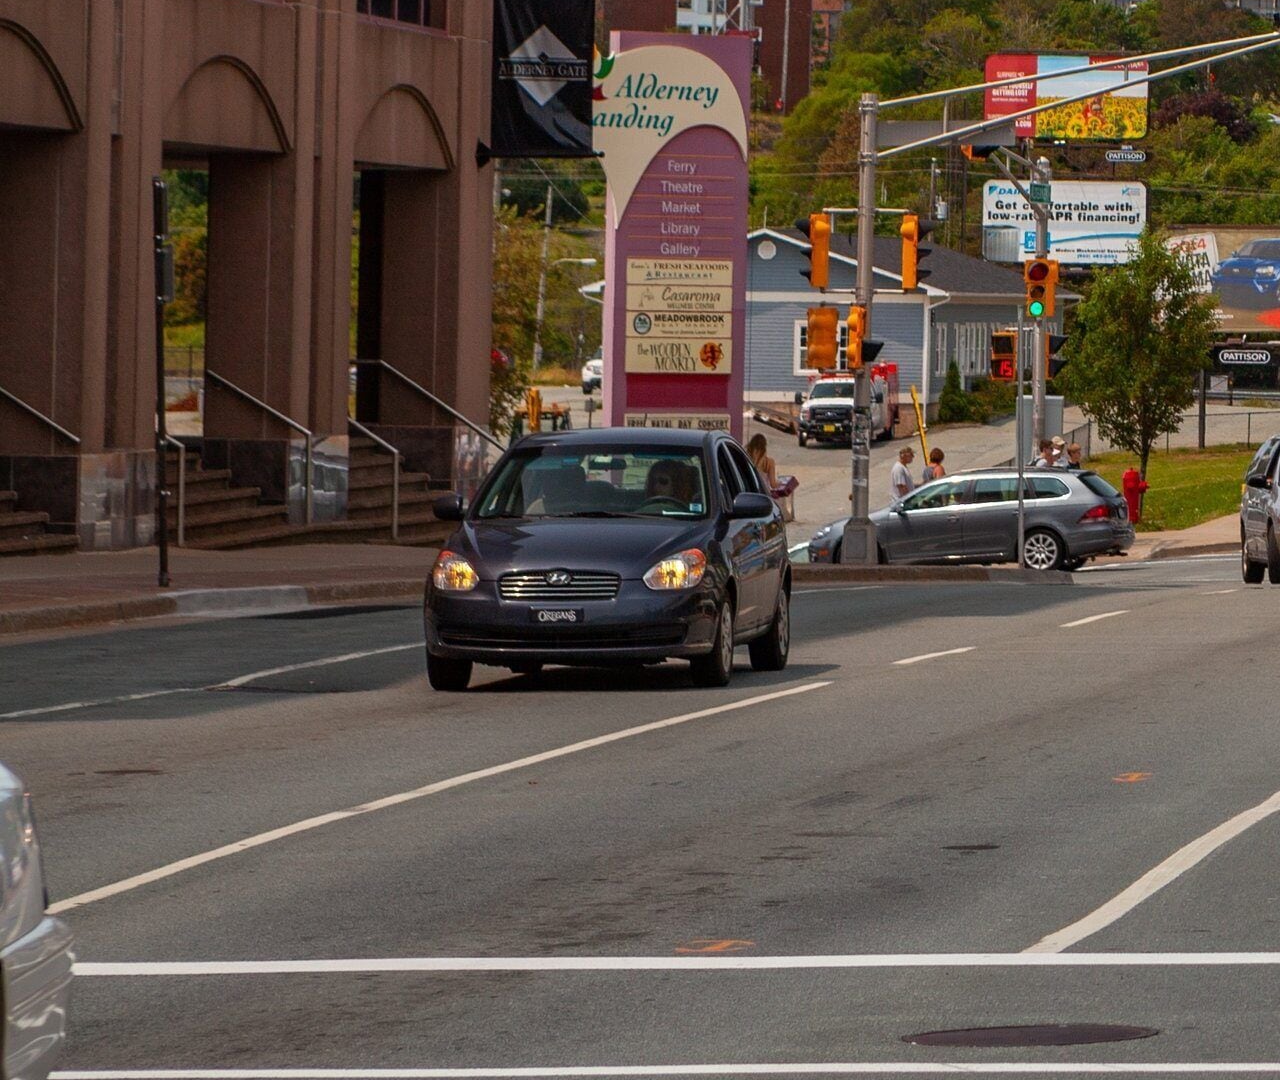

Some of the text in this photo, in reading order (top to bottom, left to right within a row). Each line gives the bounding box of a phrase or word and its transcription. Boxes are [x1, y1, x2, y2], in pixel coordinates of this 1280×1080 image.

[499, 62, 588, 76] ALDERNEY GATE
[614, 72, 719, 109] Alderney
[592, 102, 675, 137] anding
[1108, 152, 1143, 161] PATTISON
[667, 160, 697, 175] Ferry
[660, 180, 703, 194] Theatre
[661, 200, 701, 214] Market
[995, 200, 1133, 212] Get cfortable with
[1049, 212, 1073, 222] APR
[1077, 212, 1141, 225] financing!
[660, 222, 701, 236] Library
[660, 242, 701, 257] Gallery
[683, 263, 730, 271] SEAFOODS
[661, 286, 721, 301] Casaroma
[654, 314, 725, 323] MEADOWBROOK
[1223, 352, 1267, 361] PATTISON
[655, 356, 699, 372] MONKEY
